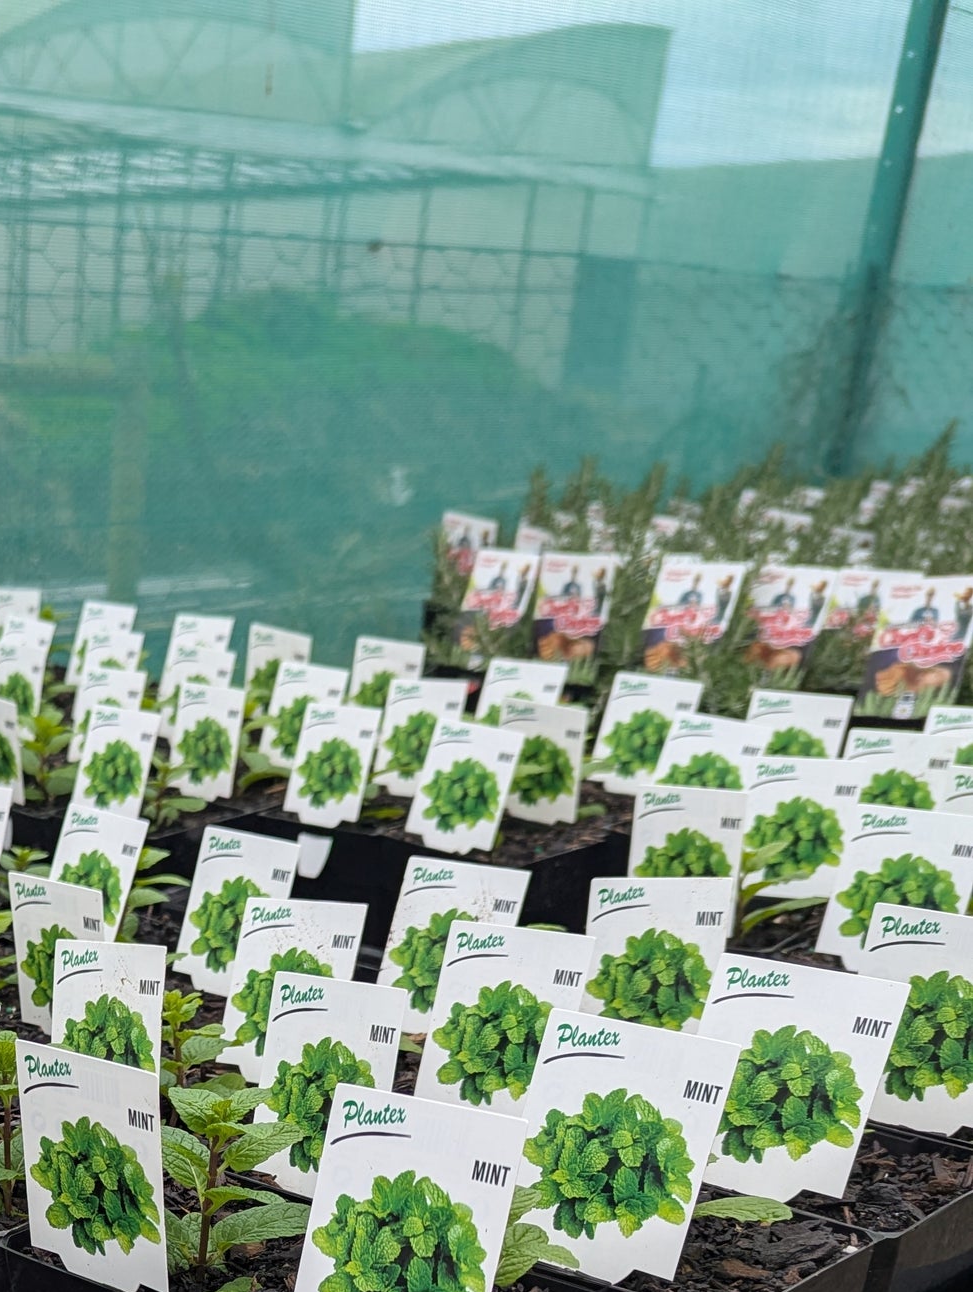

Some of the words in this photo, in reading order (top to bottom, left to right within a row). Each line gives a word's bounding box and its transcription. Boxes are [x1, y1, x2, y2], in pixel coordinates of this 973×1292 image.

[757, 763, 795, 777] Plantex
[835, 785, 857, 796] MINT
[643, 792, 681, 811] Plantex
[721, 817, 742, 829] MINT
[862, 814, 907, 829] Plantex
[209, 836, 241, 852] Plantex
[952, 844, 973, 857] MIN
[272, 868, 291, 883] MINT
[413, 867, 454, 885] Plantex
[15, 882, 46, 898] Plantex
[598, 885, 645, 907] Plantex
[251, 906, 292, 924] Plantex
[492, 899, 518, 914] MINT
[83, 917, 101, 932] MINT
[696, 911, 723, 926] MINT
[881, 916, 940, 937] Plantex
[332, 934, 356, 950] MINT
[457, 932, 505, 952] Plantex
[61, 950, 99, 970] Plantex
[553, 969, 582, 987] MINT
[727, 967, 790, 990] Plantex
[139, 980, 160, 996] MINT
[281, 984, 324, 1006] Plantex
[369, 1025, 396, 1045] MINT
[556, 1023, 620, 1048] Plantex
[852, 1016, 892, 1038] MINT
[24, 1055, 71, 1078] Plantex
[683, 1080, 723, 1104] MINT
[128, 1108, 154, 1132] MINT
[343, 1100, 406, 1128] Plantex
[471, 1160, 511, 1187] MINT
